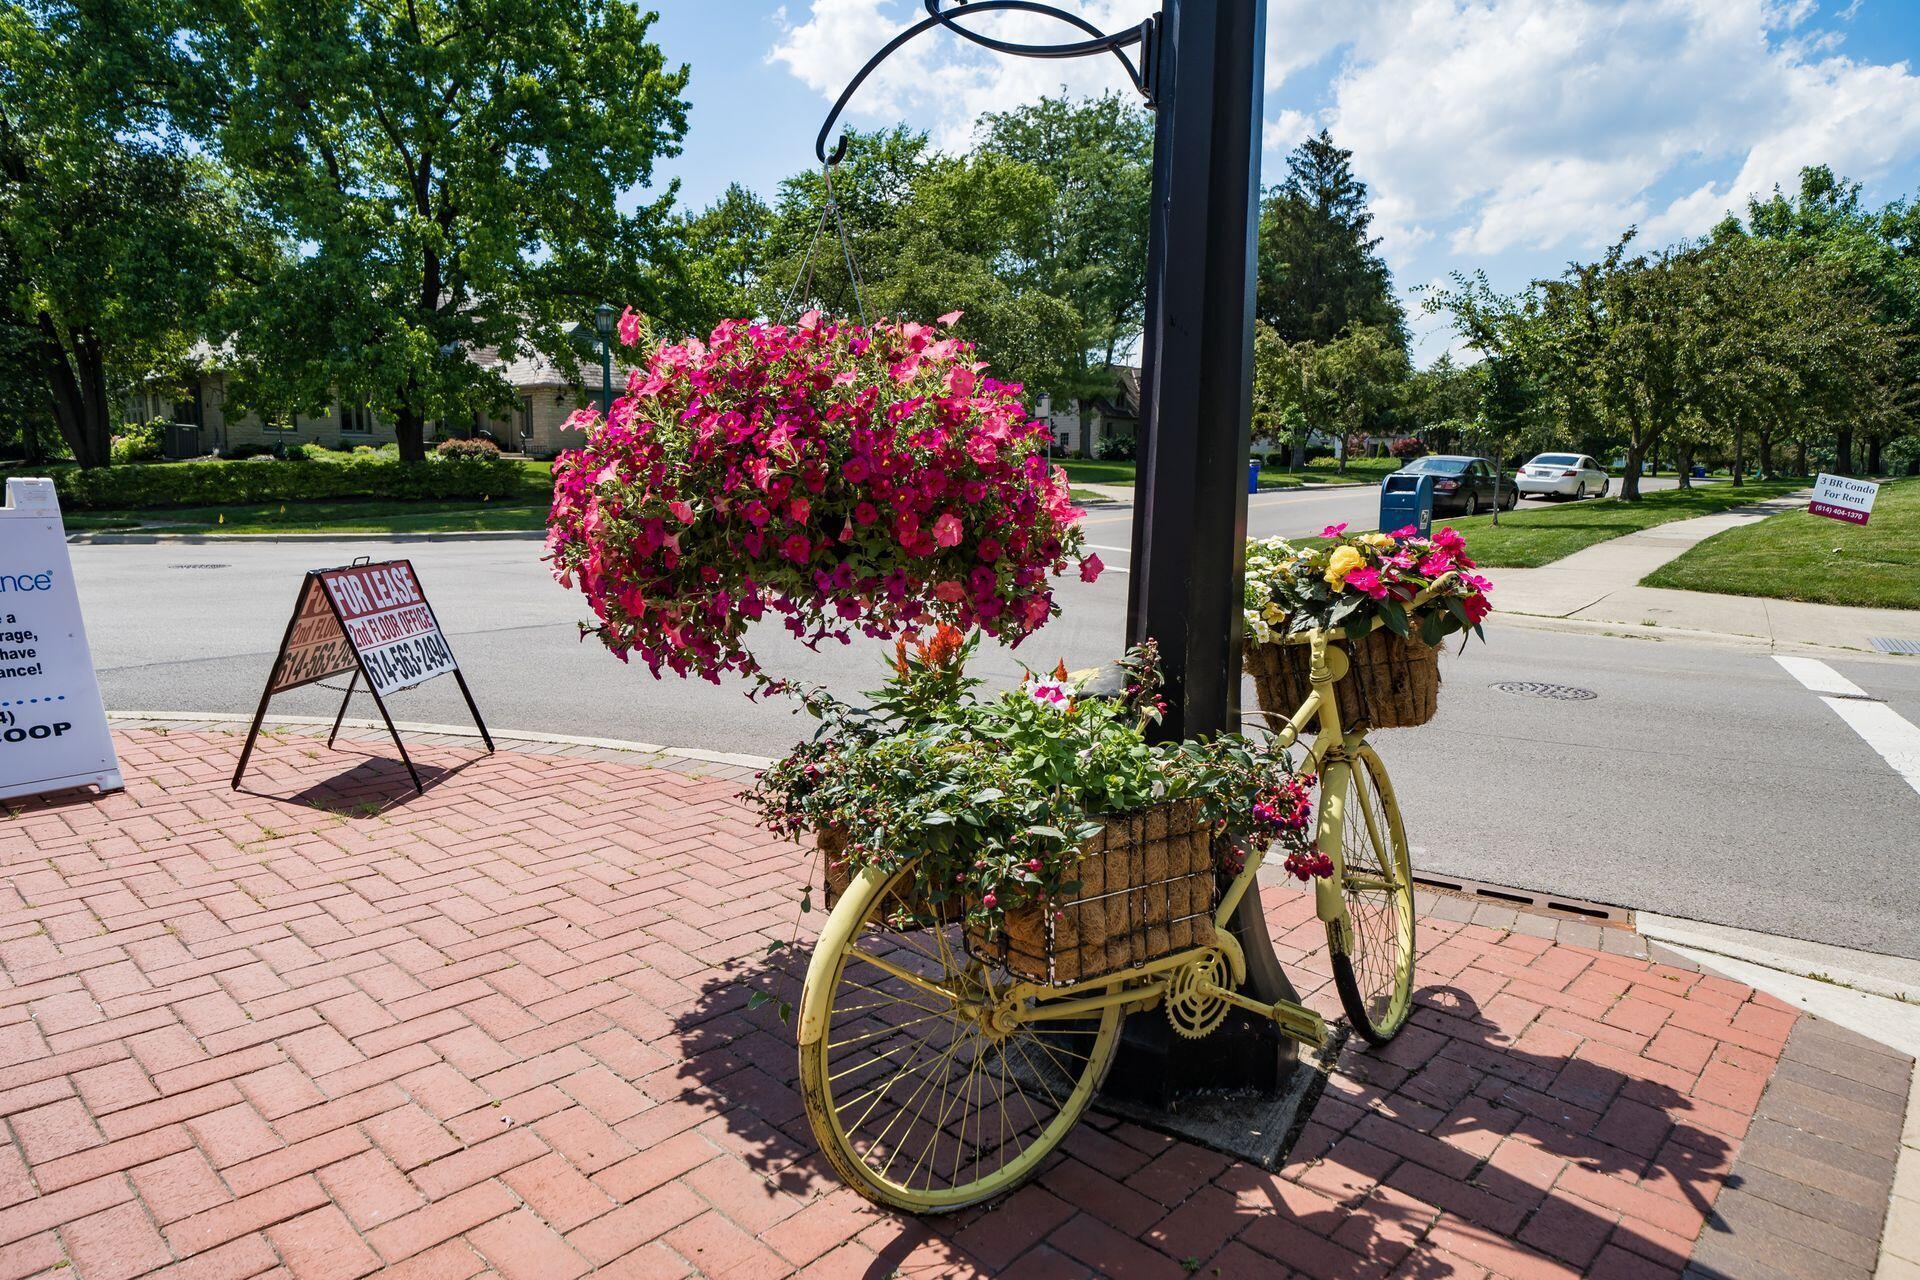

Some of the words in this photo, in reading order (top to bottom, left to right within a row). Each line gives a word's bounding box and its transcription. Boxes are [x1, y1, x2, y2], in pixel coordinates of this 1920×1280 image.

[1820, 477, 1827, 485] 3
[1829, 478, 1843, 488] BR
[1845, 481, 1875, 494] Condo
[1824, 489, 1840, 499] For
[1842, 493, 1865, 505] Rent
[1815, 504, 1832, 514] (614)
[1833, 508, 1863, 520] 404-1370
[326, 574, 373, 617] FOR
[363, 566, 420, 609] LEASE
[6, 613, 16, 624] a
[348, 620, 374, 648] 2nd
[368, 613, 403, 642] FLOOR
[398, 606, 434, 635] OFFICE
[289, 620, 315, 646] 2nd
[363, 633, 451, 689] 614-563-2494
[0, 721, 72, 743] OOP
